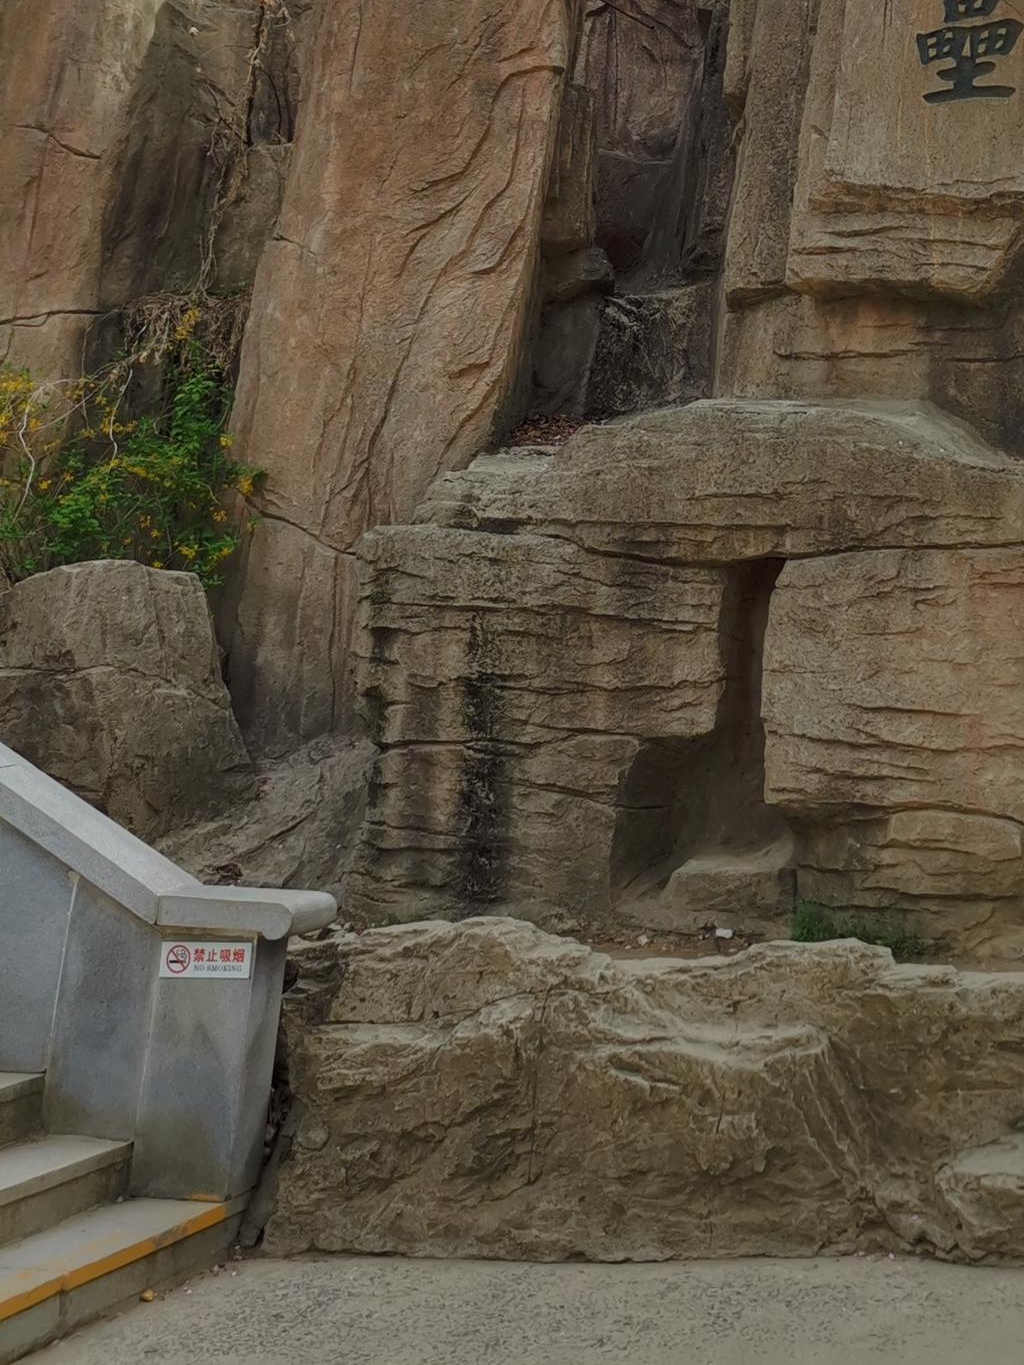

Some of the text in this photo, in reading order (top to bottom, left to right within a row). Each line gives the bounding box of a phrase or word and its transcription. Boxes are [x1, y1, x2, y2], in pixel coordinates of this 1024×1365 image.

[193, 948, 245, 963] 禁止吸烟
[206, 964, 242, 972] SMOKING
